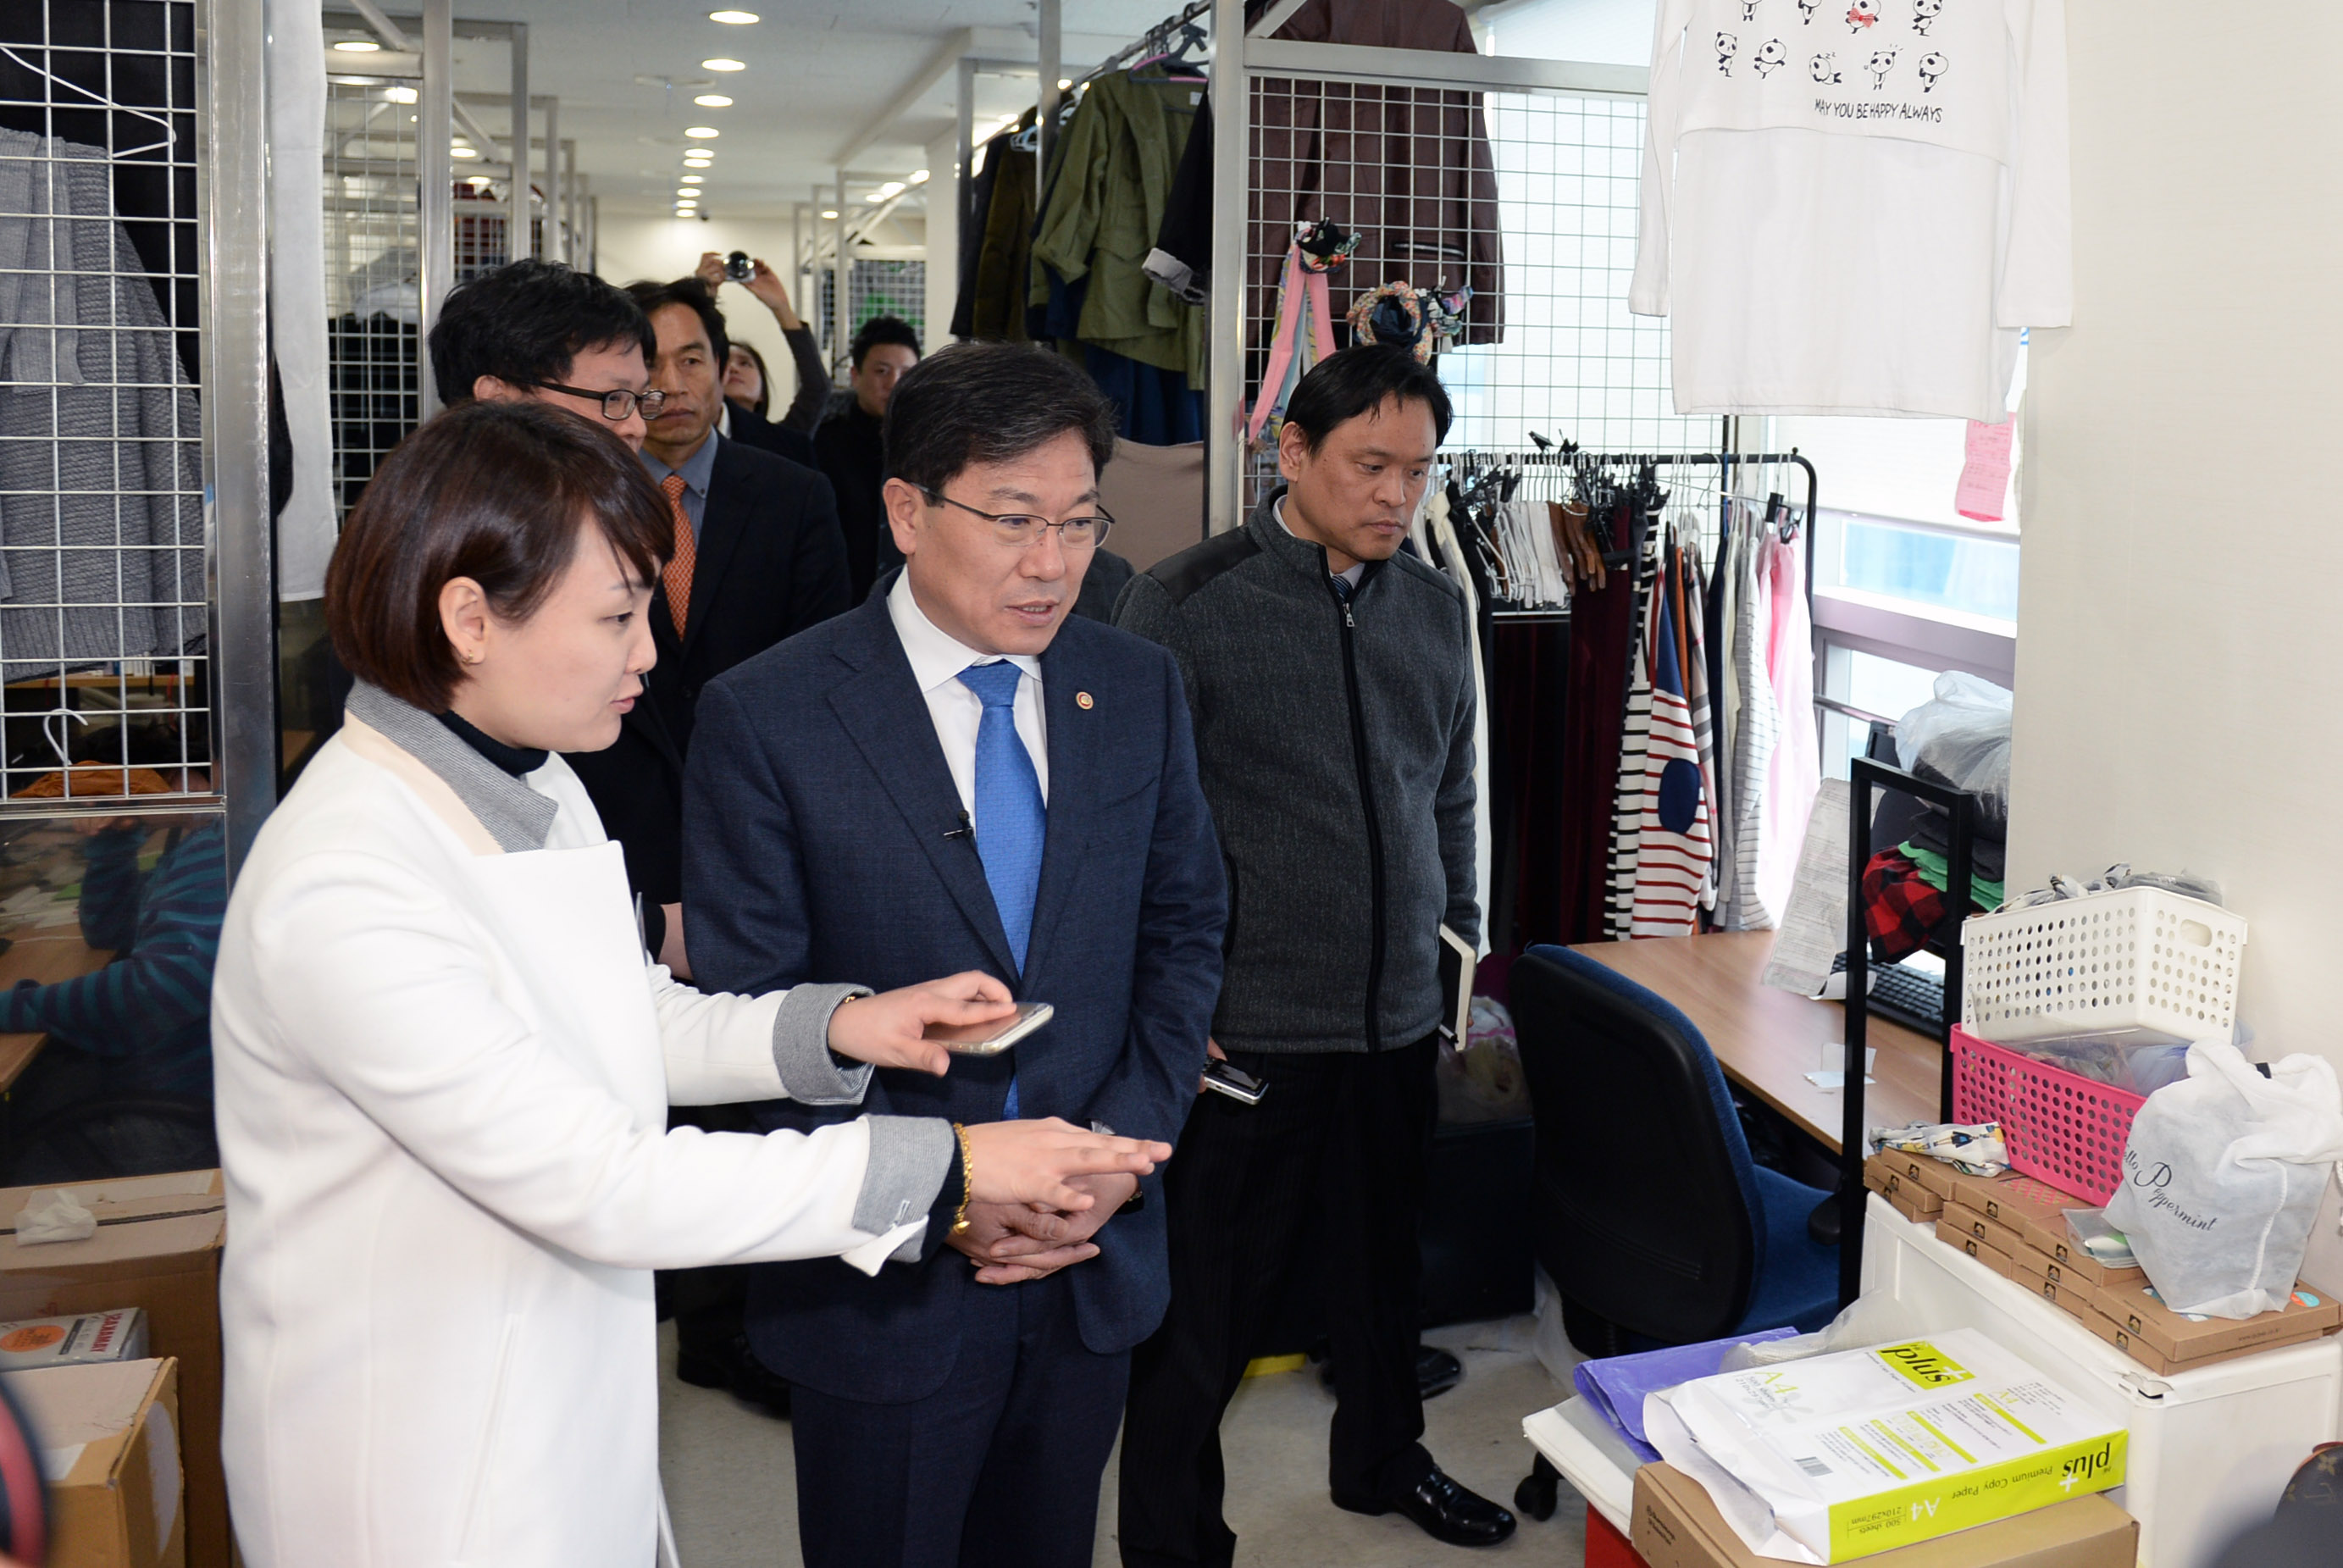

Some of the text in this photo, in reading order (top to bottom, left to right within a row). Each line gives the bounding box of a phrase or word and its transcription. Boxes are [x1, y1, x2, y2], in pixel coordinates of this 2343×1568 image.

[1815, 98, 1943, 123] MAY YOU BE HAPPY ALWAYS
[1880, 1348, 1951, 1382] plus
[1755, 1372, 1798, 1393] A4
[2062, 1442, 2110, 1478] plus
[1952, 1466, 2053, 1499] Premium Copy Paper
[1852, 1506, 1902, 1525] 210x297mm
[1911, 1498, 1941, 1521] A4
[1858, 1518, 1902, 1534] 500 sheets
